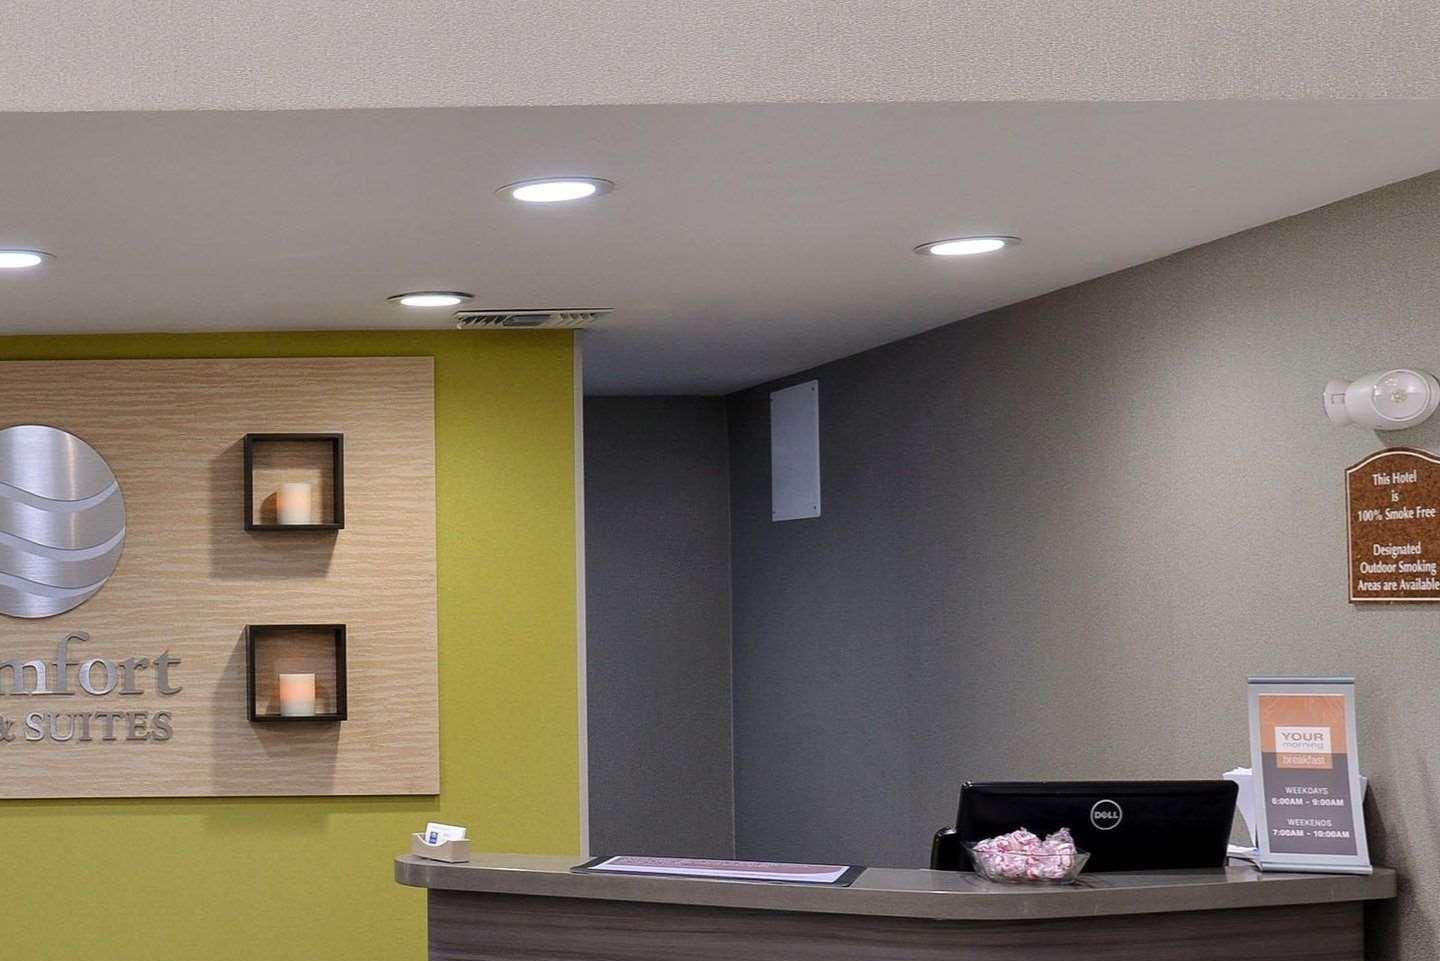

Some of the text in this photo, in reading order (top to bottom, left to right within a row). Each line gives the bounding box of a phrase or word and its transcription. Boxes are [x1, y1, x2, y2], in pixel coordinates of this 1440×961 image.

[1372, 469, 1417, 486] This Hotel
[1391, 490, 1399, 502] is
[1358, 506, 1436, 522] 100% Smoke Free
[1373, 541, 1422, 559] Designated
[1360, 560, 1437, 576] Outdoor Smoking
[1357, 578, 1440, 591] Areas are Available
[24, 711, 174, 742] SUITES
[1281, 732, 1324, 741] YOUR
[1285, 787, 1329, 795] WEEKDAYS
[1094, 811, 1119, 819] DELL
[1287, 818, 1333, 827] WEEKENDS
[1272, 829, 1304, 837] 7:00AM
[1313, 830, 1350, 838] 10:00AM
